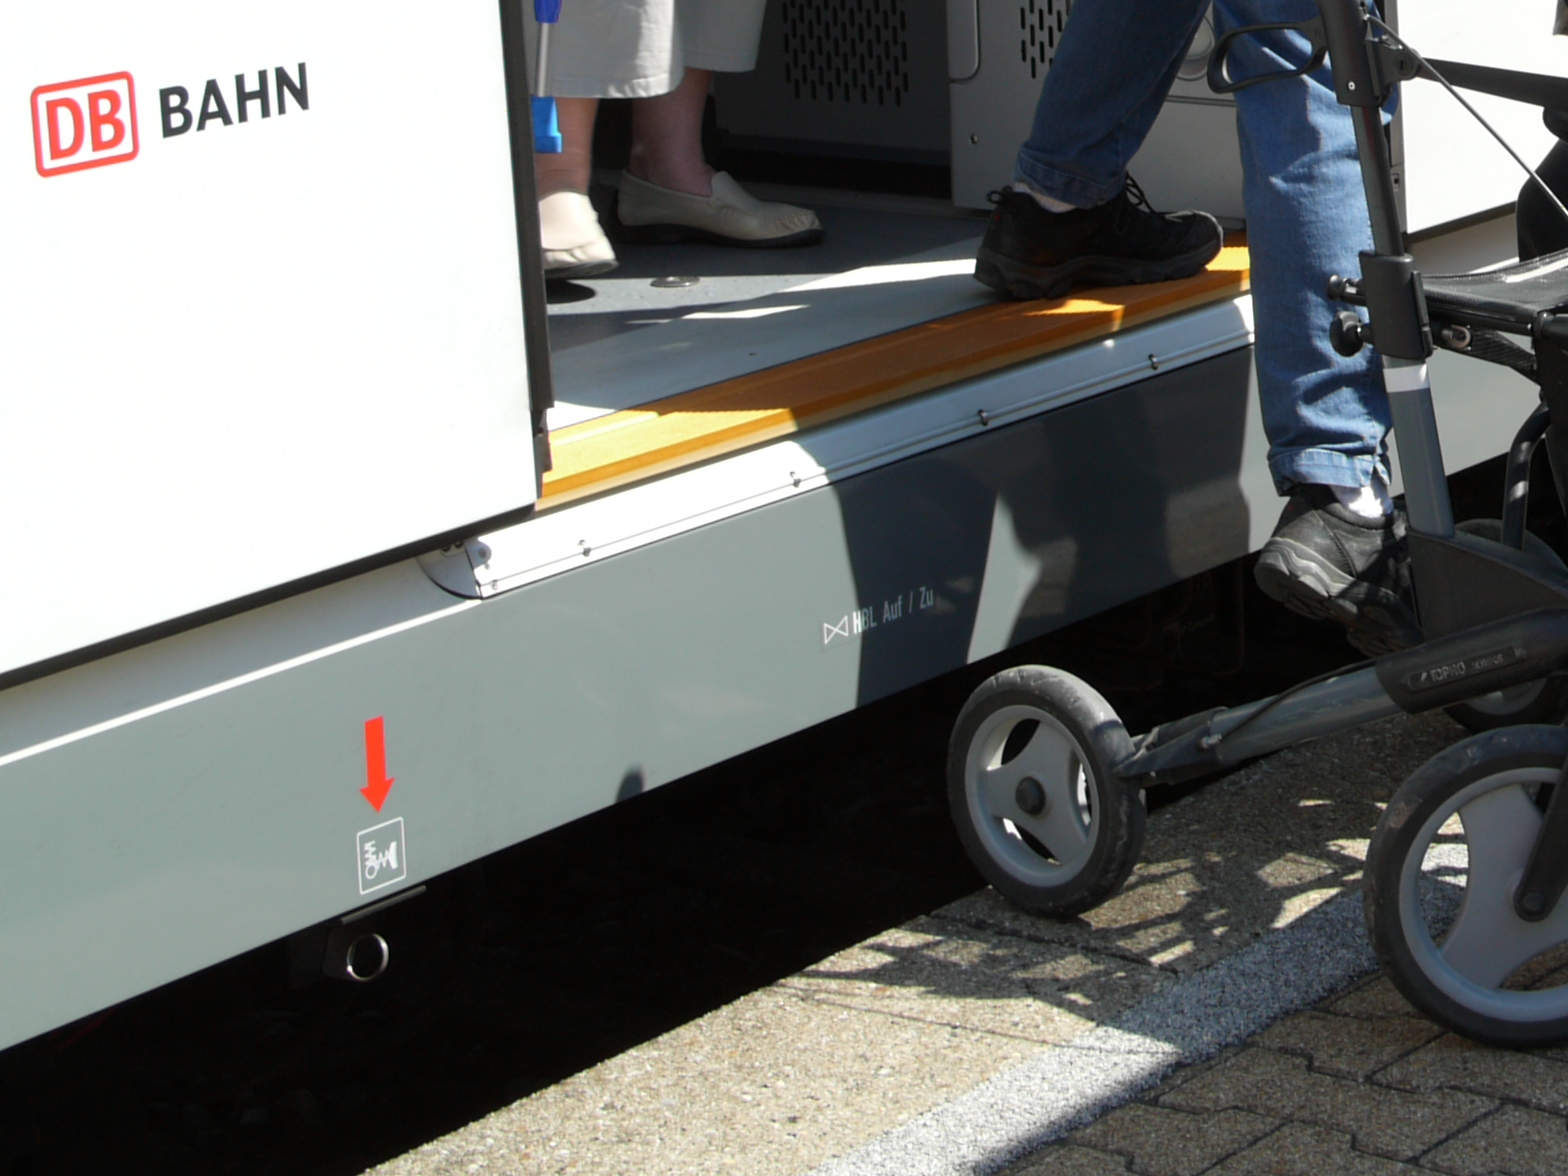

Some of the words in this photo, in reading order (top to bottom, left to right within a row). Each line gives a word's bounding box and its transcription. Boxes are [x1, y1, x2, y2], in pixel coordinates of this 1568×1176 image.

[46, 88, 126, 160] DB
[159, 62, 310, 139] BAHN
[919, 586, 934, 610] Zu
